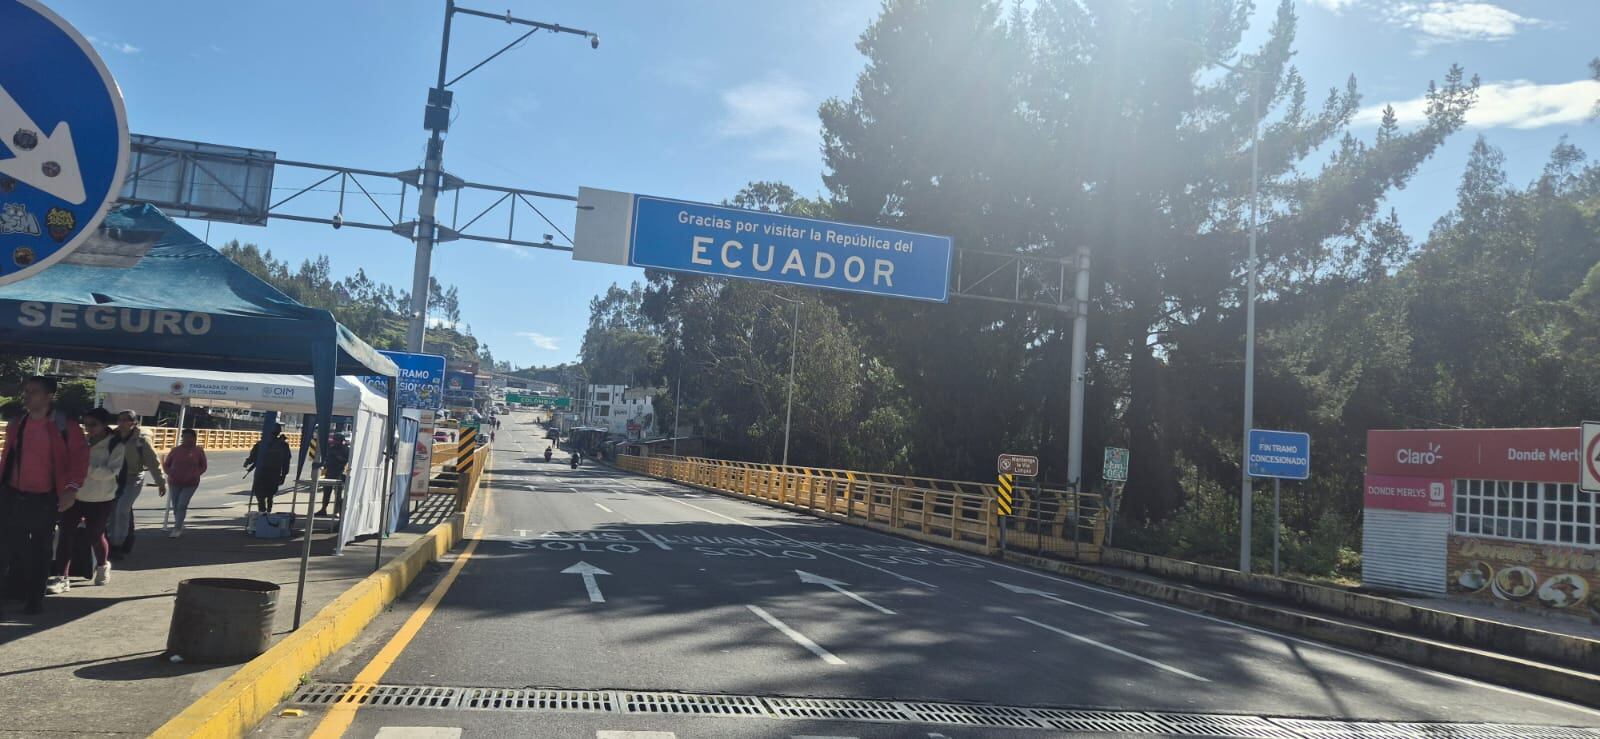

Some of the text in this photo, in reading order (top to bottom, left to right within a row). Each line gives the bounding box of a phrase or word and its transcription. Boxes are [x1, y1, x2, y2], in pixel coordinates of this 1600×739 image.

[678, 210, 914, 254] Gracias por visitar la República del
[691, 235, 895, 287] ECUADOR
[17, 301, 212, 335] SEGURO
[273, 387, 295, 397] OIM
[1259, 443, 1298, 454] FIN TRAMO
[1507, 447, 1581, 462] Donde Merl
[1250, 454, 1307, 466] CONCESIONADO
[1397, 448, 1436, 465] Claro
[1368, 486, 1426, 498] DONDE MERLYS
[512, 529, 627, 541] TAXIS
[510, 541, 640, 553] SOLO
[694, 546, 817, 559] SOLO
[859, 553, 985, 568] SOLO
